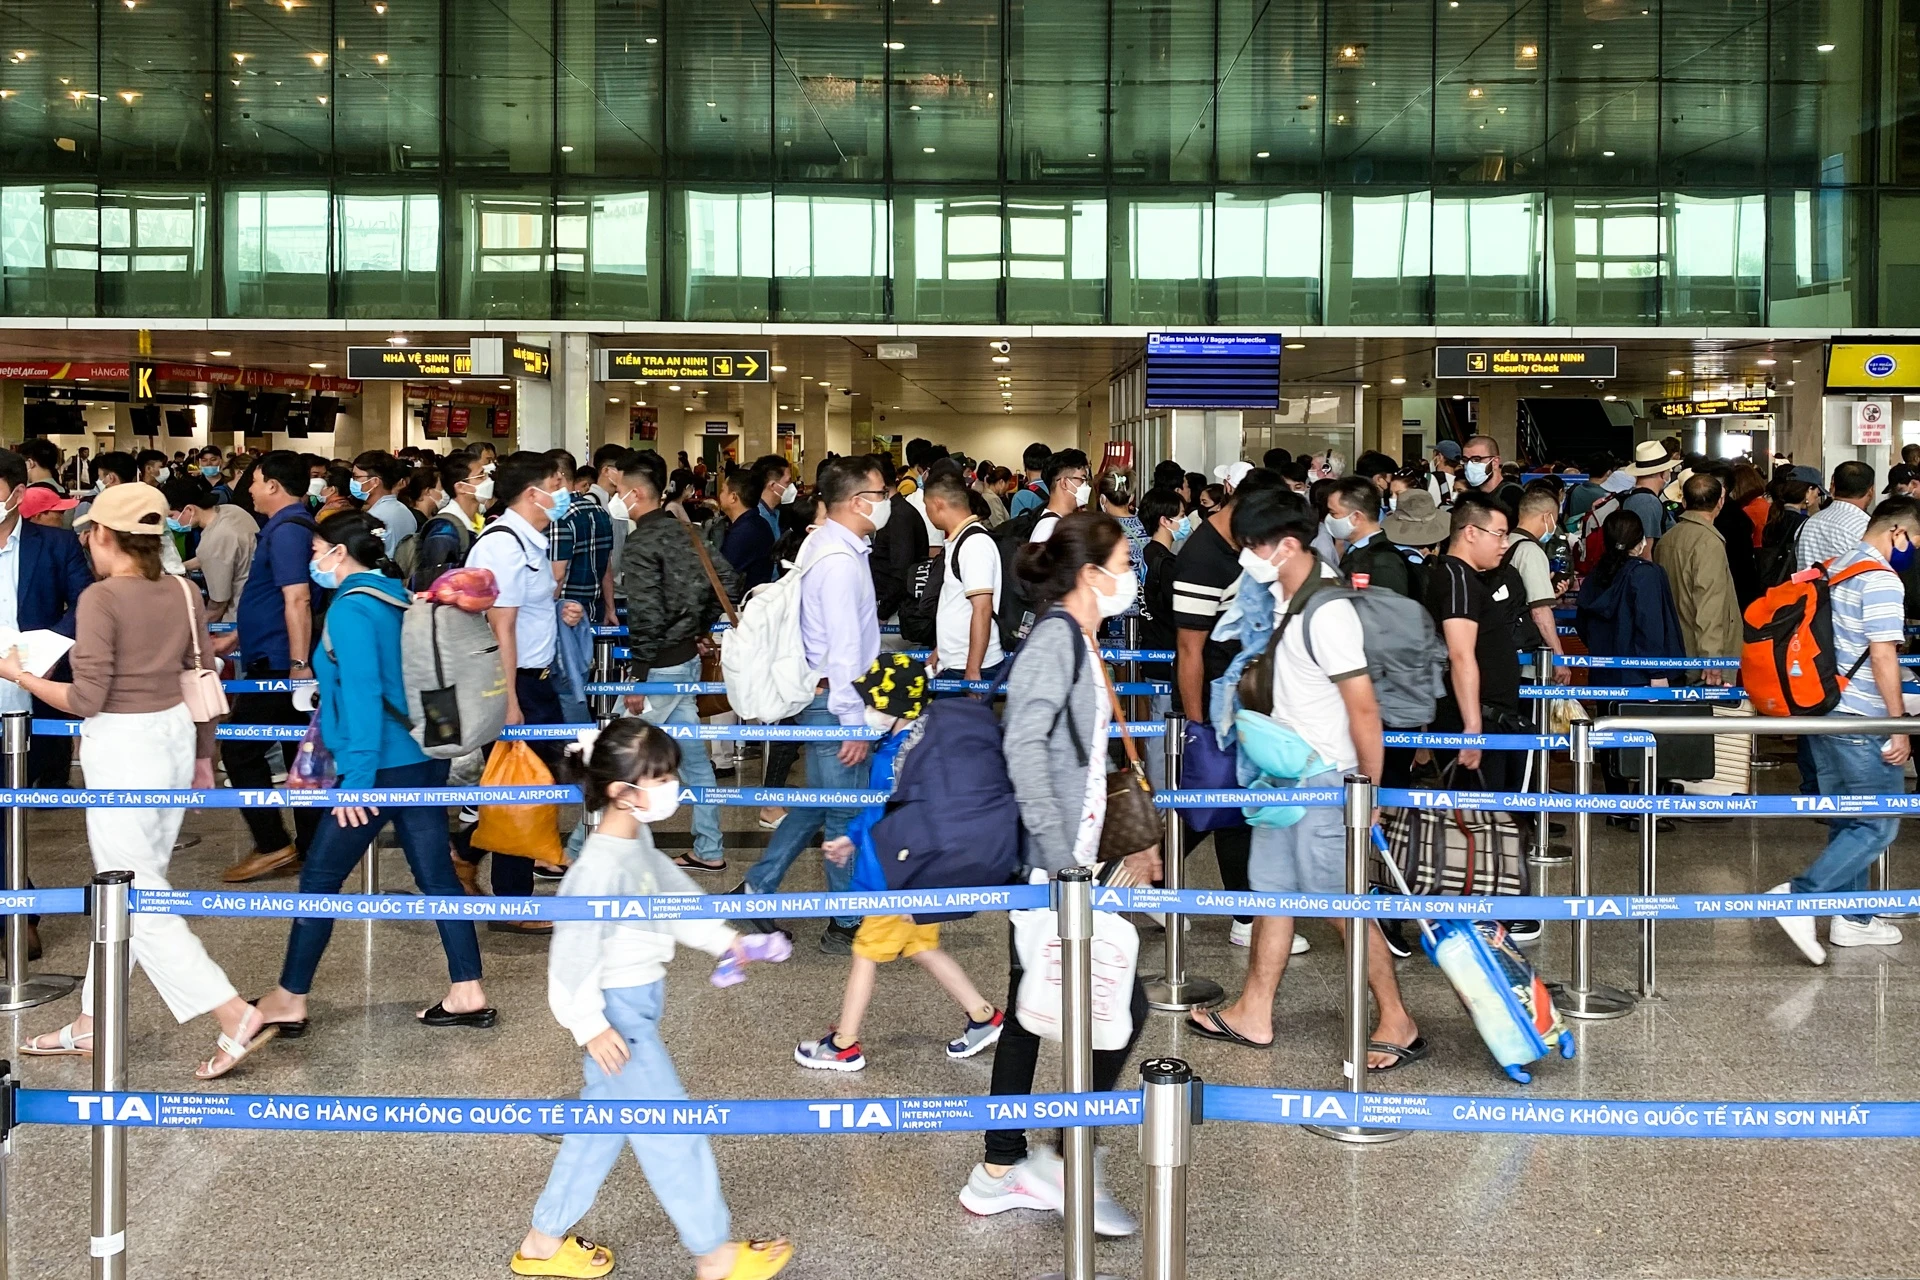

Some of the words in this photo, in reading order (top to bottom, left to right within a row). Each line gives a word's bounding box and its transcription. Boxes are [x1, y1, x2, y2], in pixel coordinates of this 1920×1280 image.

[383, 352, 405, 362] NHÀ
[408, 352, 422, 364] VỆ
[425, 354, 449, 363] SINH
[616, 353, 641, 365] KIỂM
[643, 357, 664, 365] TRA
[666, 357, 680, 365] AN
[683, 357, 707, 365] NINH
[1494, 350, 1518, 362] KIỂM
[1521, 354, 1542, 362] TRA
[1543, 354, 1558, 362] AN
[1560, 354, 1584, 362] NINH
[198, 369, 202, 380] K
[419, 365, 449, 373] Toilets
[642, 368, 678, 377] Security
[680, 368, 708, 376] Check
[1494, 364, 1530, 373] Security
[1531, 364, 1559, 372] Check
[139, 368, 152, 398] K
[247, 374, 256, 384] K-1
[1560, 655, 1589, 665] TIA
[256, 681, 287, 690] TIA
[1672, 690, 1700, 698] TIA
[740, 727, 764, 736] CẢNG
[766, 728, 790, 736] HÀNG
[793, 728, 823, 737] KHÔNG
[826, 727, 849, 737] QUỐC
[852, 727, 862, 736] TẾ
[1386, 734, 1410, 743] QUỐC
[1412, 734, 1423, 744] TẾ
[1425, 735, 1441, 744] TÂN
[1464, 735, 1486, 745] NHẤT
[1536, 736, 1569, 747] TIA
[16, 792, 58, 803] KHÔNG
[62, 792, 96, 804] QUỐC
[100, 792, 114, 804] TẾ
[118, 793, 141, 804] TÂN
[145, 795, 170, 804] SƠN
[174, 792, 206, 803] NHẤT
[239, 791, 285, 804] TIA
[336, 793, 358, 802] TAN
[362, 793, 386, 802] SON
[390, 793, 420, 802] NHAT
[424, 792, 516, 801] INTERNATIONAL
[518, 790, 569, 799] AIRPORT
[755, 791, 784, 801] CẢNG
[787, 792, 817, 802] HÀNG
[820, 792, 857, 803] KHÔNG
[1174, 794, 1202, 802] NHAT
[1205, 794, 1289, 802] INTERNATIONAL
[1292, 792, 1338, 801] AIRPORT
[1408, 792, 1453, 806] TIA
[1504, 795, 1536, 806] CẢNG
[1540, 796, 1572, 807] HÀNG
[1576, 798, 1616, 808] KHÔNG
[1620, 798, 1652, 809] QUỐC
[1656, 798, 1670, 809] TẾ
[1674, 799, 1696, 809] TÂN
[1699, 801, 1723, 810] SƠN
[1727, 798, 1757, 809] NHẤT
[1791, 797, 1836, 810] TIA
[1886, 798, 1908, 807] TAN
[202, 895, 245, 909] CẢNG
[250, 896, 294, 910] HÀNG
[299, 898, 352, 912] KHÔNG
[358, 899, 401, 913] QUỐC
[406, 899, 424, 914] TẾ
[429, 900, 458, 914] TÂN
[463, 903, 496, 914] SƠN
[500, 901, 540, 915] NHẤT
[713, 901, 740, 912] TAN
[746, 900, 776, 912] SON
[782, 899, 820, 911] NHAT
[825, 896, 942, 909] INTERNATIONAL
[946, 892, 1010, 905] AIRPORT
[1196, 892, 1234, 906] CẢNG
[1238, 894, 1276, 908] HÀNG
[1280, 896, 1328, 909] KHÔNG
[1332, 894, 1370, 910] QUỐC
[1375, 897, 1392, 911] TẾ
[1395, 899, 1421, 912] TÂN
[1425, 902, 1454, 912] SƠN
[1458, 899, 1493, 913] NHẤT
[1564, 900, 1622, 916] TIA
[1694, 901, 1720, 911] TAN
[1725, 901, 1753, 911] SON
[1758, 900, 1793, 910] NHAT
[1797, 897, 1905, 909] INTERNATIONAL
[588, 901, 646, 917] TIA
[162, 1096, 181, 1104] TAN
[182, 1096, 201, 1105] SON
[205, 1097, 229, 1106] NHAT
[902, 1102, 920, 1110] TAN
[922, 1101, 941, 1109] SON
[944, 1101, 968, 1109] NHAT
[1272, 1094, 1347, 1118] TIA
[1362, 1096, 1380, 1105] TAN
[1382, 1097, 1400, 1105] SON
[1404, 1098, 1427, 1106] NHAT
[68, 1096, 152, 1120] TIA
[162, 1106, 235, 1117] INTERNATIONAL
[249, 1099, 309, 1119] CẢNG
[317, 1101, 377, 1121] HÀNG
[385, 1104, 462, 1123] KHÔNG
[470, 1104, 531, 1124] QUỐC
[538, 1104, 564, 1124] TẾ
[571, 1105, 612, 1124] TÂN
[620, 1108, 665, 1124] SƠN
[673, 1104, 730, 1124] NHẤT
[986, 1103, 1026, 1119] TAN
[1034, 1101, 1077, 1117] SON
[1085, 1098, 1140, 1115] NHAT
[1362, 1106, 1433, 1116] INTERNATIONAL
[1453, 1101, 1505, 1120] CẢNG
[1512, 1103, 1564, 1122] HÀNG
[1570, 1106, 1638, 1124] KHÔNG
[1644, 1105, 1698, 1125] QUỐC
[1704, 1105, 1727, 1125] TẾ
[1732, 1107, 1768, 1125] TÂN
[1775, 1111, 1814, 1125] SƠN
[1821, 1105, 1870, 1124] NHẤT
[162, 1117, 204, 1126] AIRPORT
[809, 1104, 892, 1127] TIA
[902, 1111, 974, 1120] INTERNATIONAL
[1362, 1116, 1402, 1125] AIRPORT
[902, 1121, 943, 1129] AIRPORT
